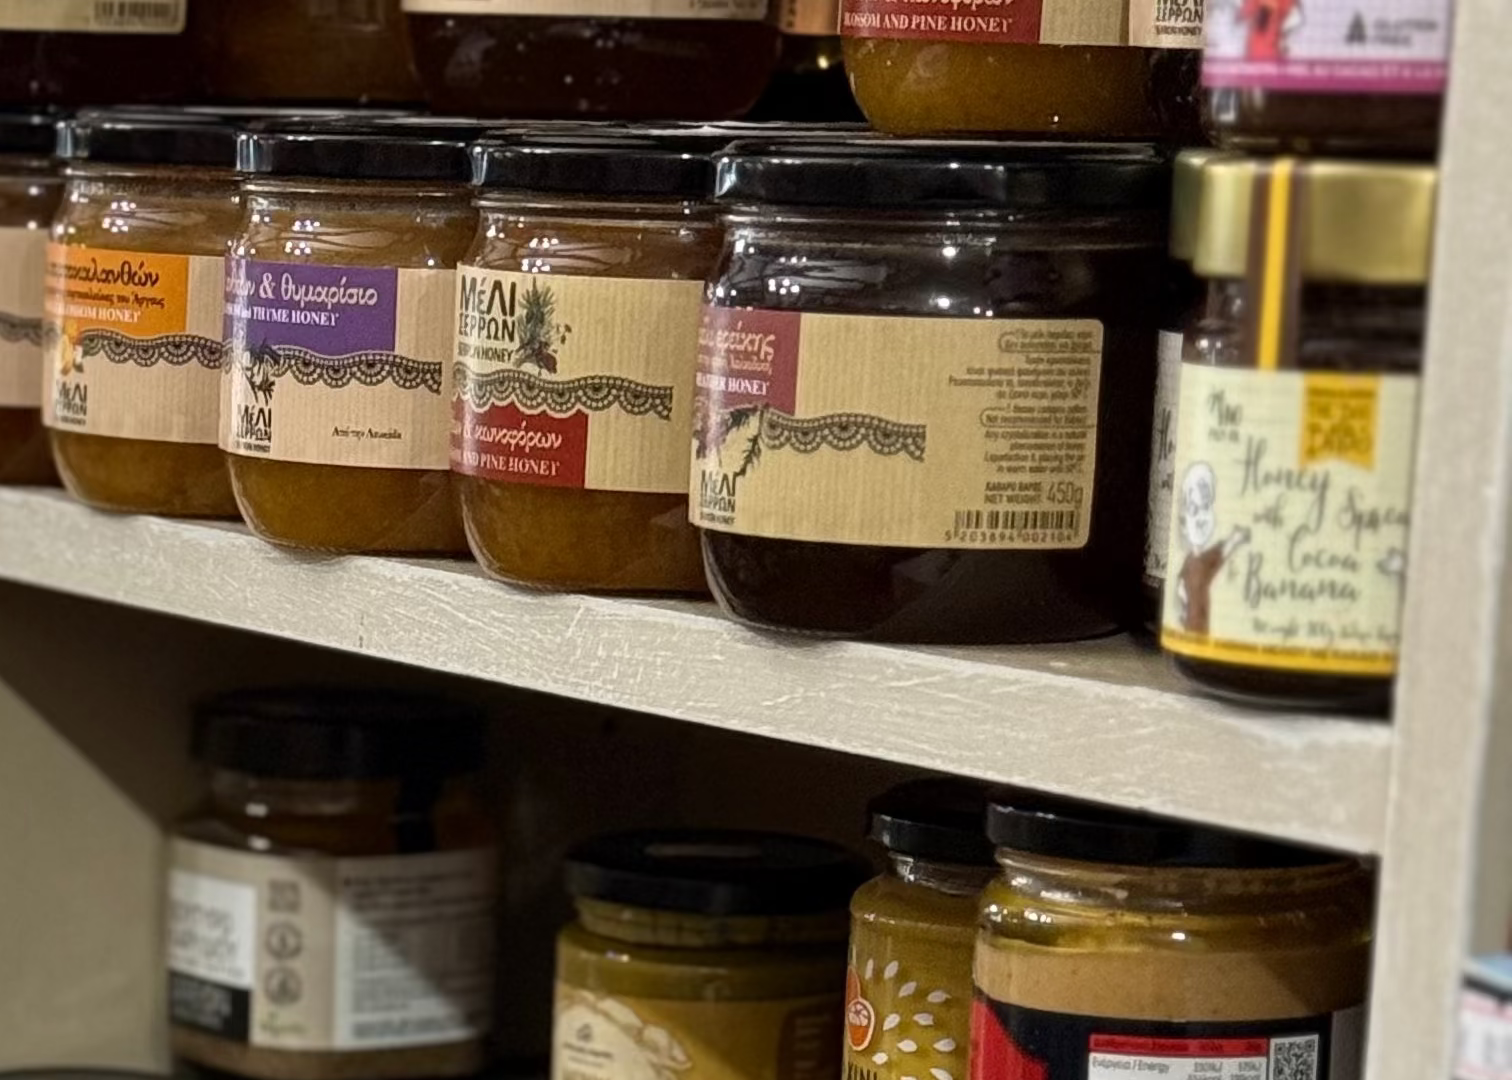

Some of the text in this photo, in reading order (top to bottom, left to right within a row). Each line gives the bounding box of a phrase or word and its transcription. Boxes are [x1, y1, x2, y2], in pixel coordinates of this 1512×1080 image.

[884, 14, 909, 29] AND
[911, 14, 947, 31] PINE
[950, 16, 1013, 33] HONEY
[259, 272, 275, 299] &
[98, 307, 141, 323] HONEY
[252, 307, 290, 323] THYME
[291, 309, 340, 327] HONEY
[727, 376, 770, 396] HONEY
[480, 454, 507, 471] PINE
[507, 458, 560, 477] HONEY
[1244, 551, 1361, 609] Banana
